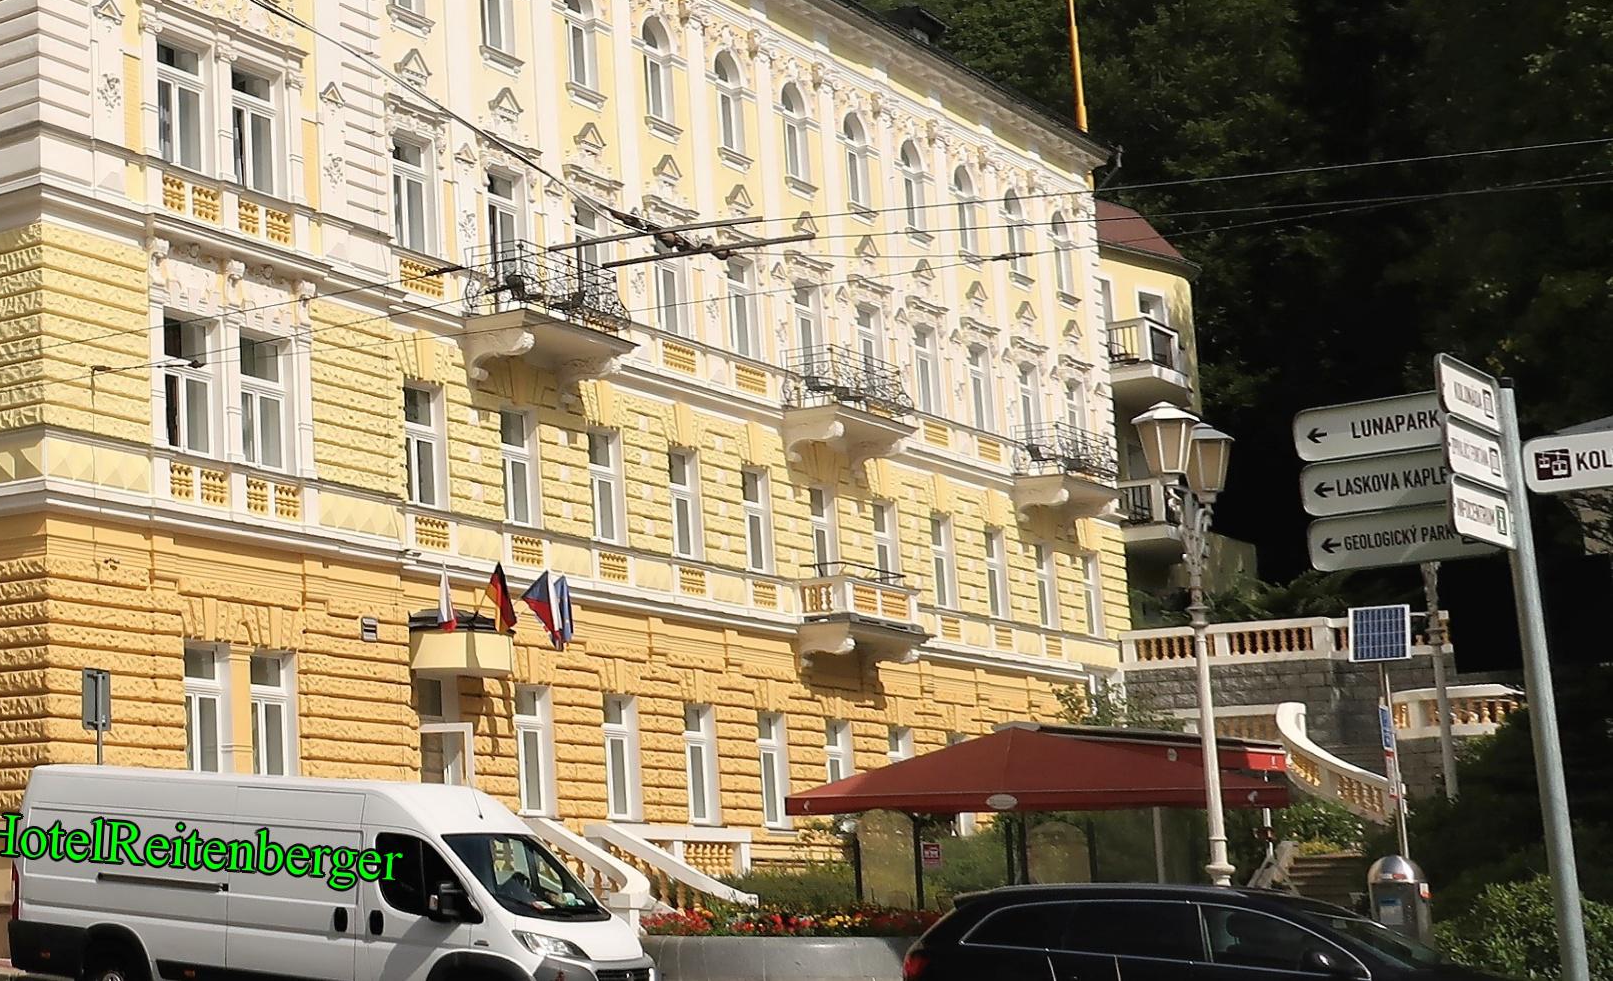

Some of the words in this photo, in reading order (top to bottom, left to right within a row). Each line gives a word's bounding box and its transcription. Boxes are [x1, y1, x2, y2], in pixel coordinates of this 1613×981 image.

[1351, 409, 1441, 439] LUNAPARK
[1336, 472, 1400, 497] LASKOVA
[1344, 524, 1417, 551] GEOLOGICKÝ
[1421, 524, 1455, 542] PARK
